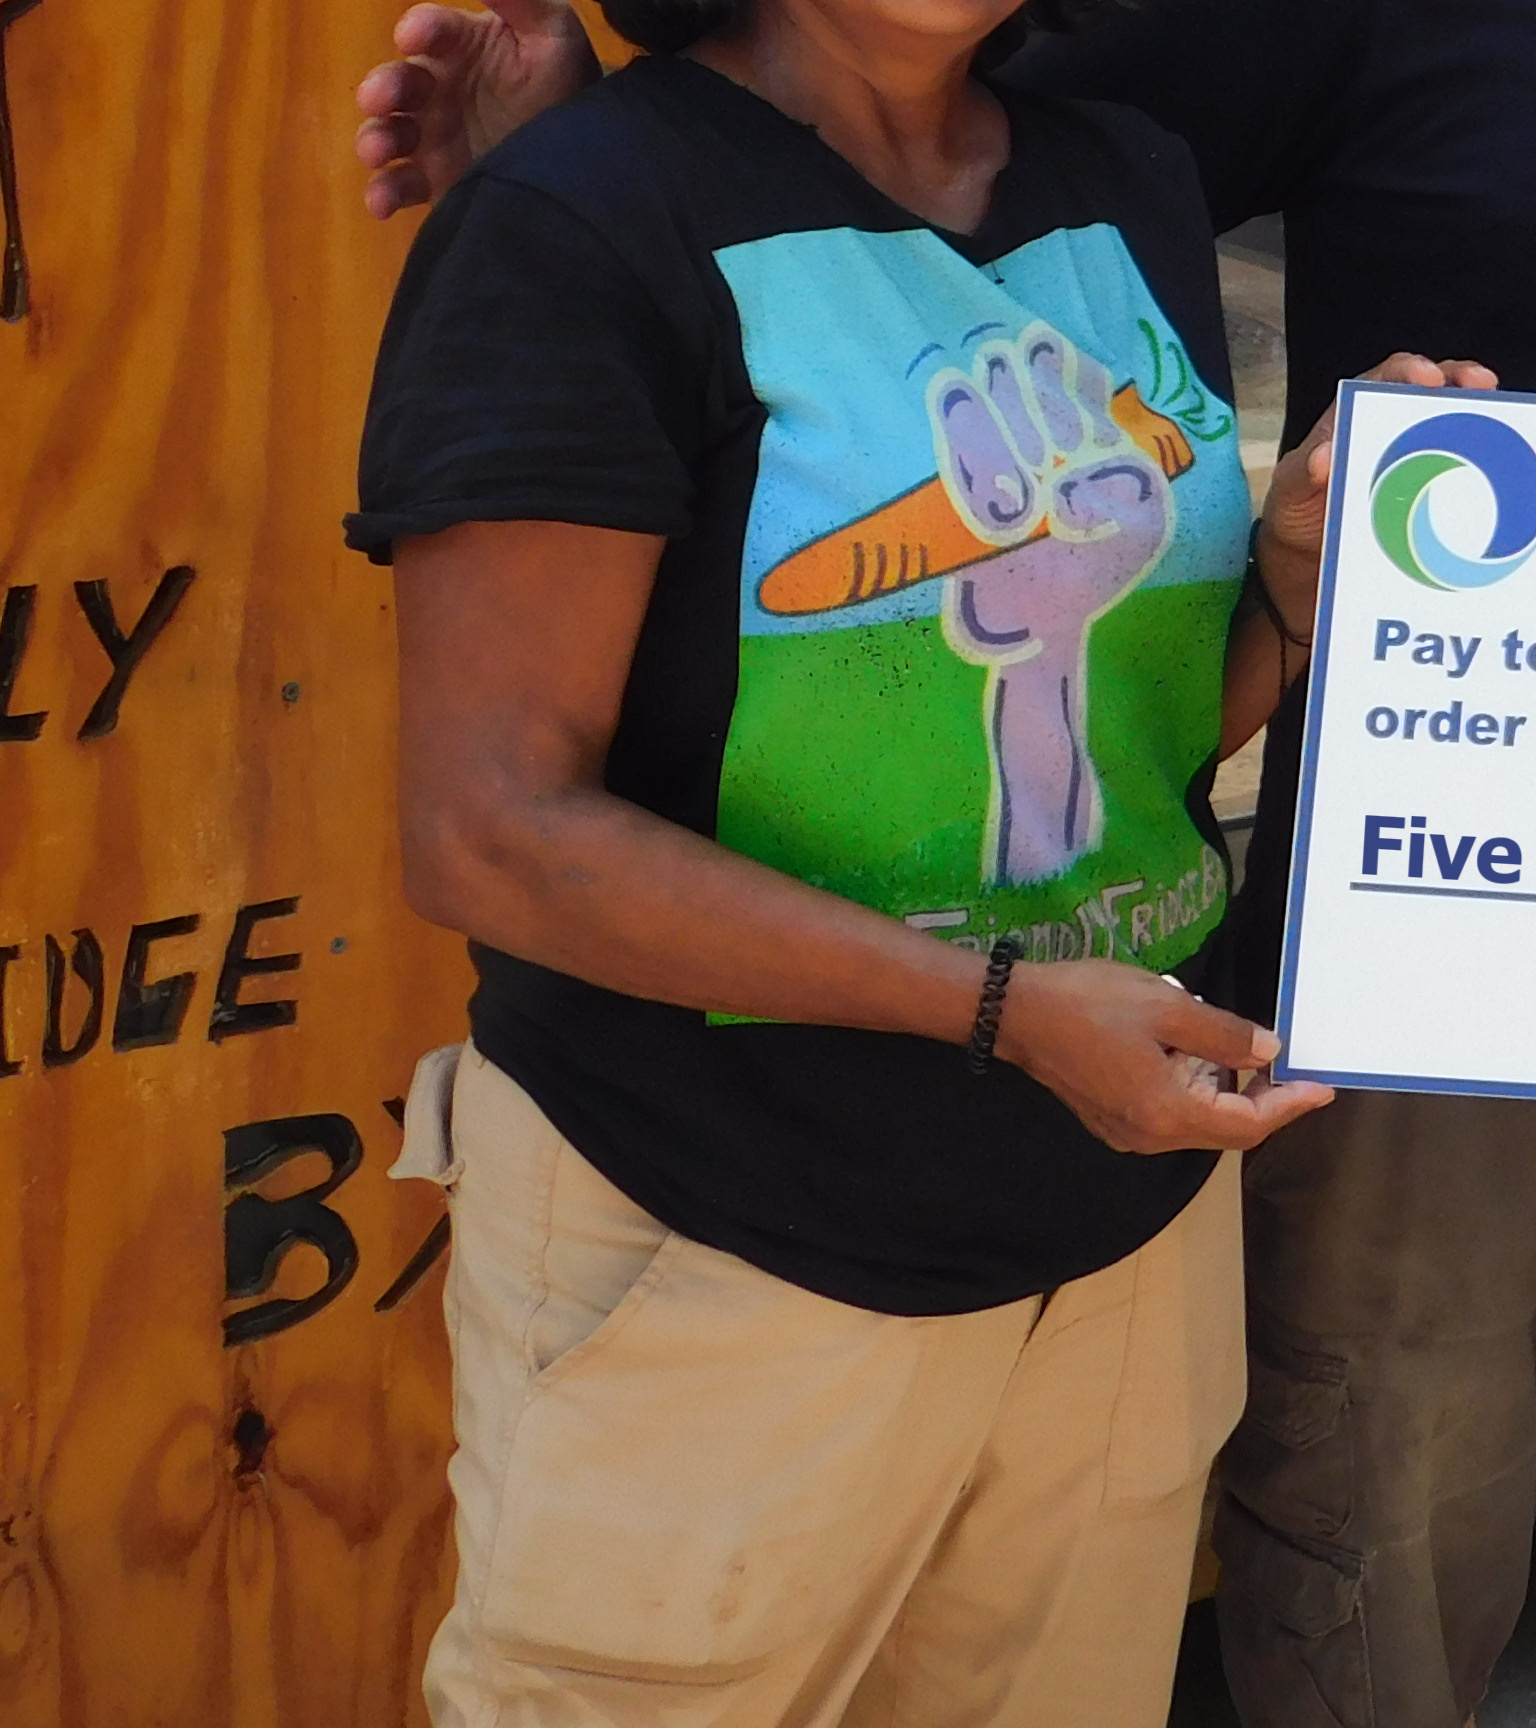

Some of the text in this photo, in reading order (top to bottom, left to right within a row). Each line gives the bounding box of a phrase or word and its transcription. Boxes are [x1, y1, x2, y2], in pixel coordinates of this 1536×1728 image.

[1374, 619, 1482, 679] Pay
[1364, 700, 1527, 747] order
[1361, 814, 1523, 885] Five
